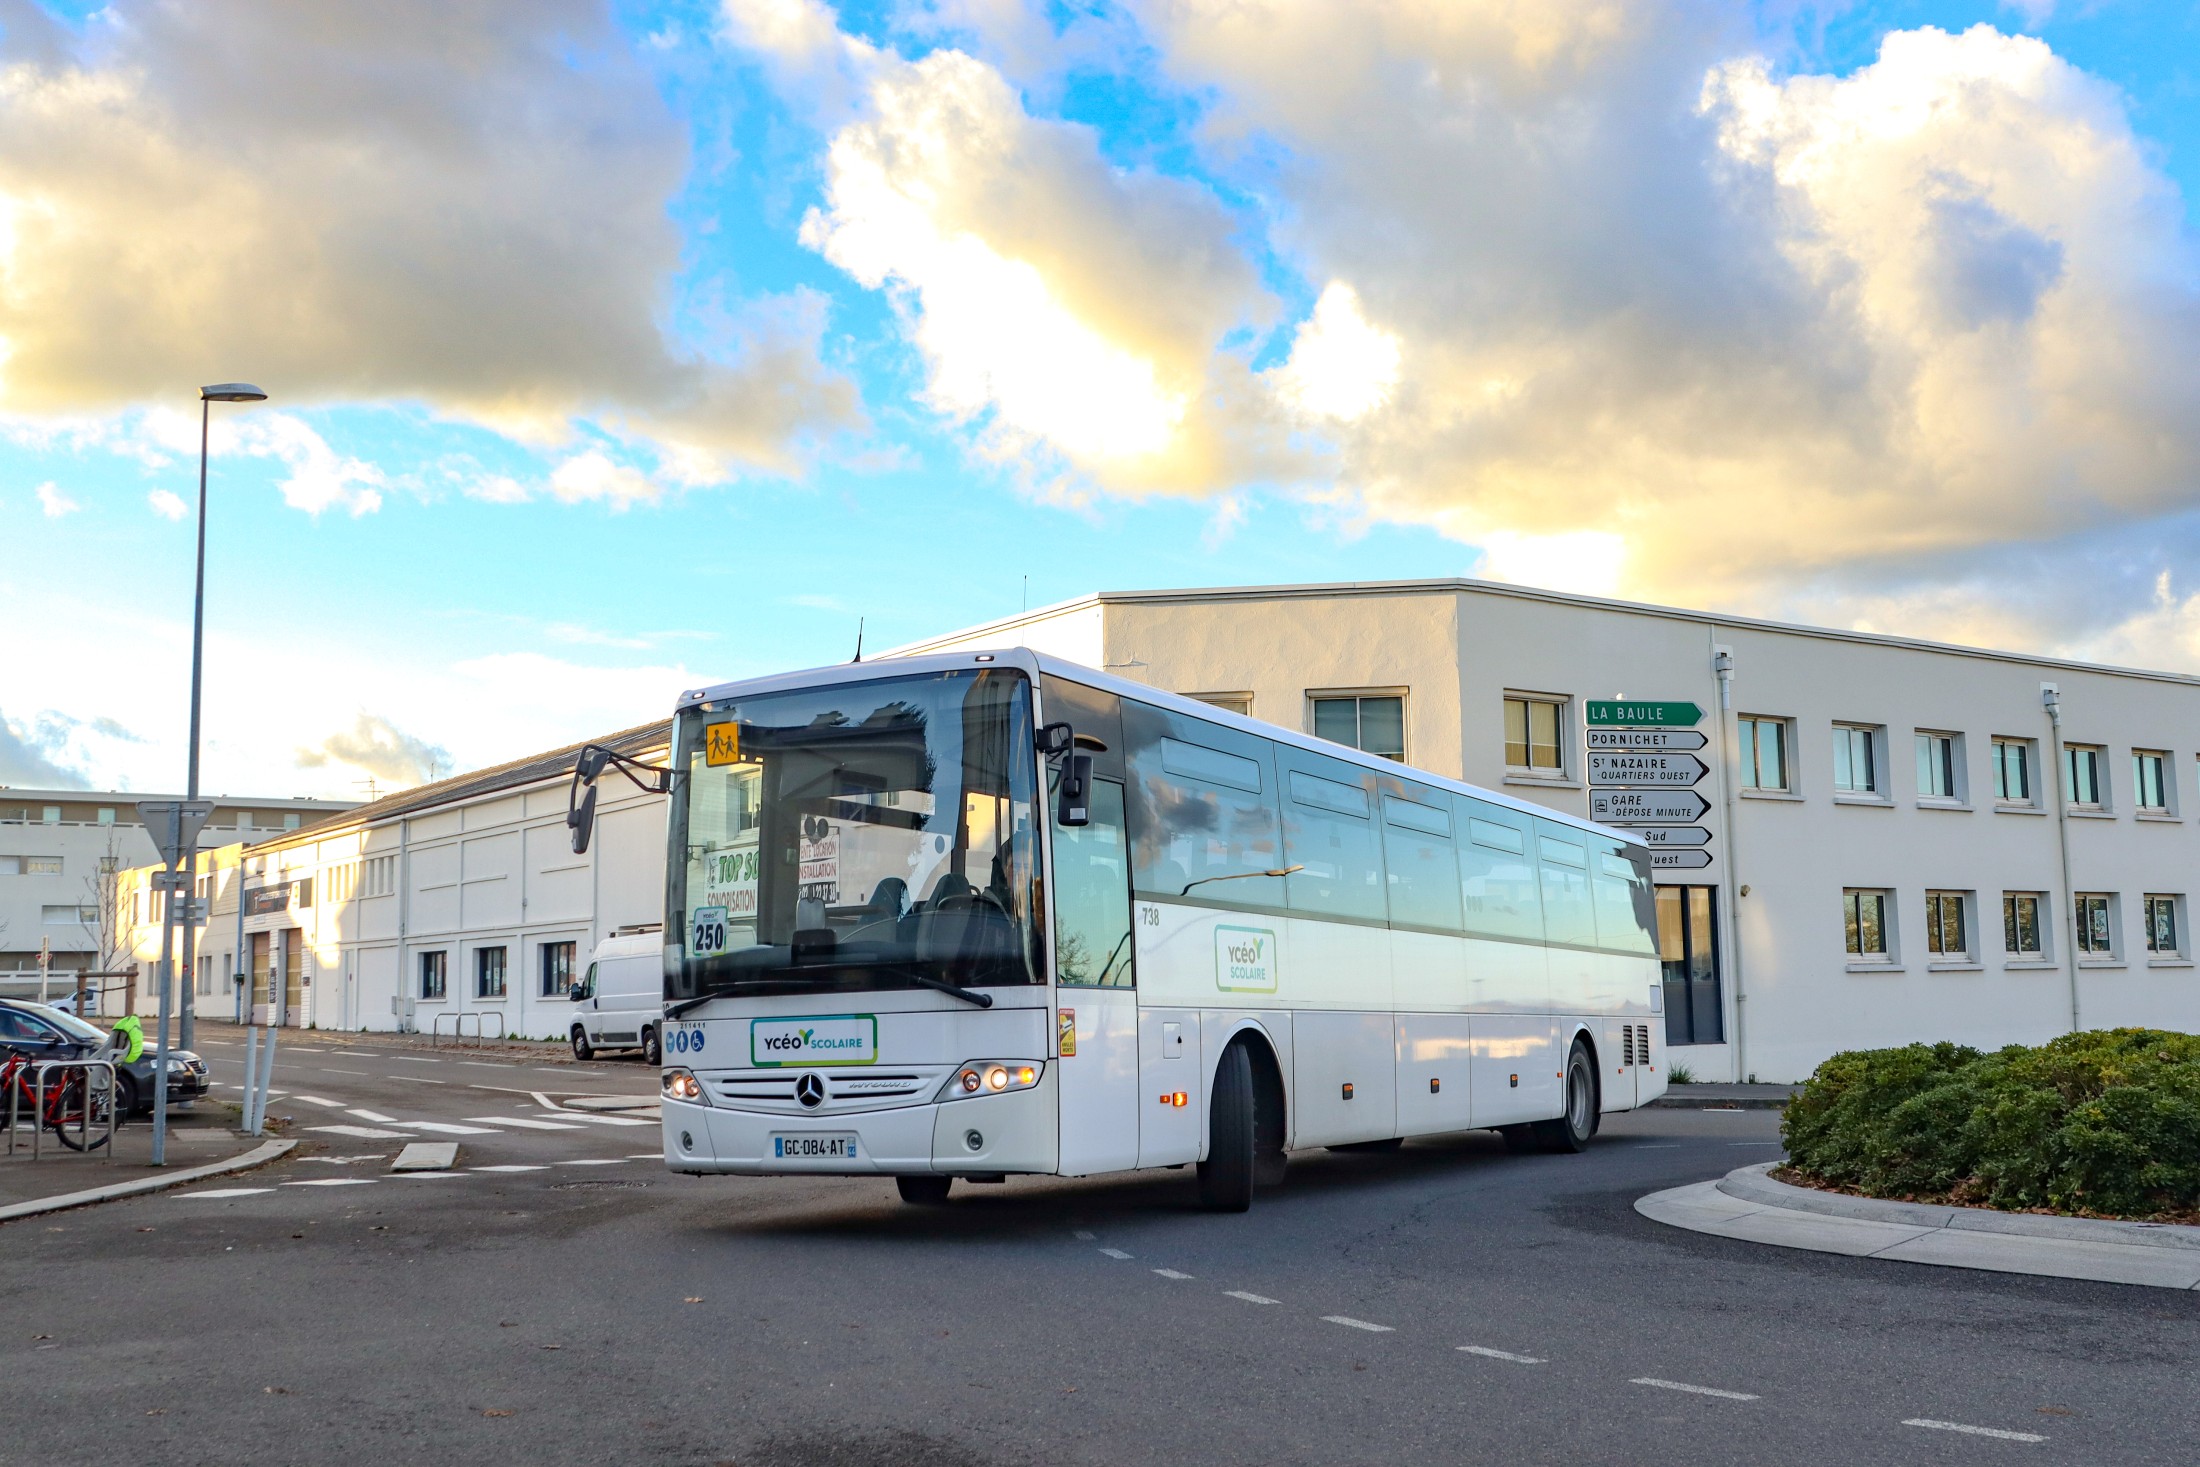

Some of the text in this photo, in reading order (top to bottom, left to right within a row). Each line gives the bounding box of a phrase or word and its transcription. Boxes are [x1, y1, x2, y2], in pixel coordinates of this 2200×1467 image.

[1592, 707, 1664, 720] LA BAULE
[1592, 735, 1667, 745] PORNICHET
[1612, 759, 1667, 769] NAZAIRE
[1660, 772, 1691, 781] OUEST
[1612, 795, 1642, 806] GARE
[1656, 808, 1692, 817] MINUTE
[1645, 831, 1667, 841] Sud
[800, 844, 811, 859] ENTE
[1650, 854, 1679, 865] uest
[719, 854, 744, 883] TOP
[800, 862, 837, 879] NSTALLATION
[707, 889, 756, 912] SONORISATION
[1142, 907, 1160, 927] 738
[695, 922, 724, 951] 250
[1230, 966, 1266, 981] SCOLAIRE
[810, 1038, 863, 1049] SCOLAIRE
[784, 1139, 845, 1156] GC-084-AT
